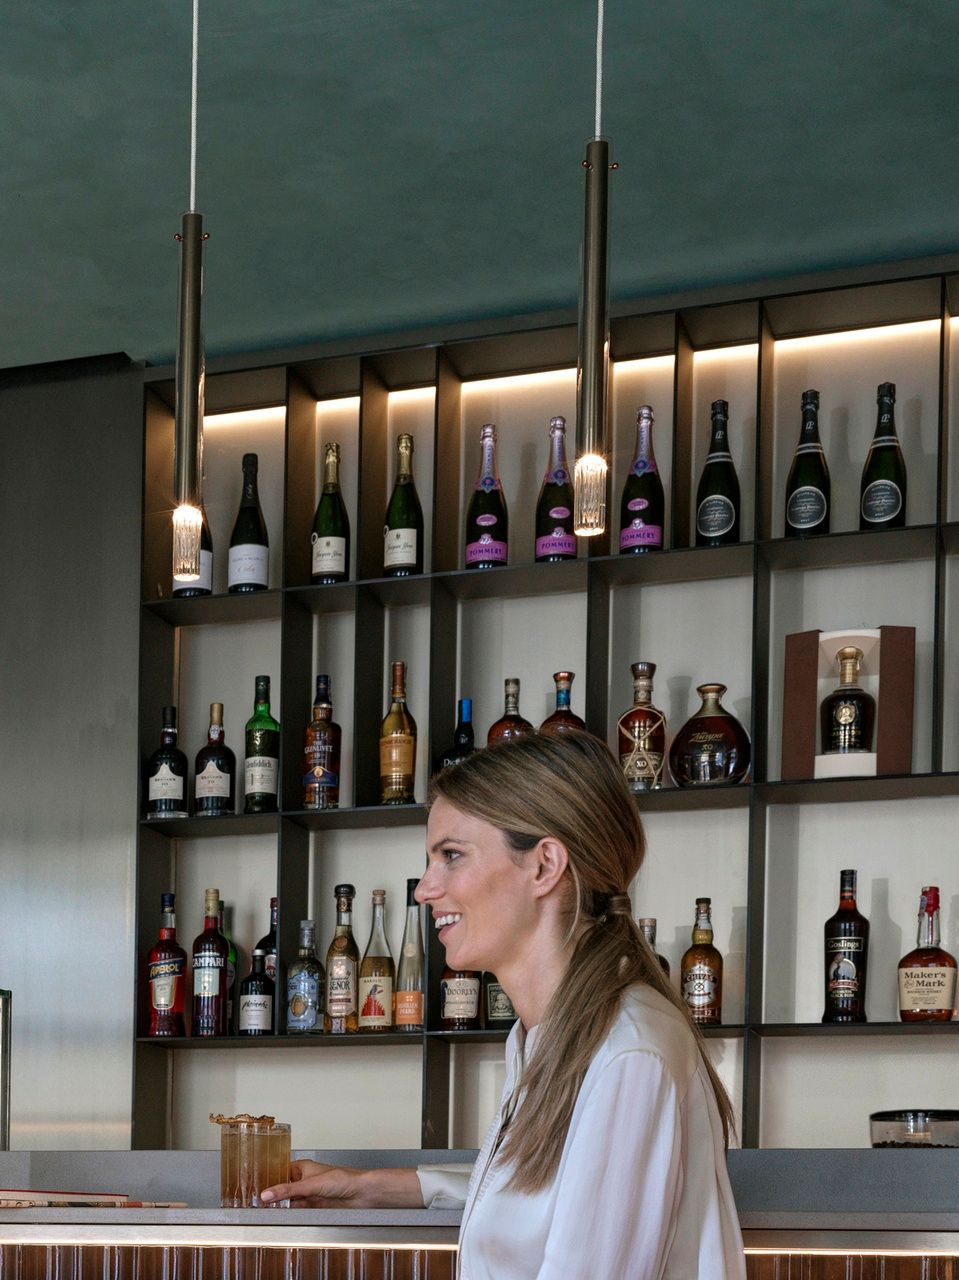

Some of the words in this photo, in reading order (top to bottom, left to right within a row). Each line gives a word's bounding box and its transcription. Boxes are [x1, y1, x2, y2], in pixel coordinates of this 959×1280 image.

[304, 745, 334, 754] GLENLIVET
[828, 940, 859, 949] Goslings
[149, 963, 179, 977] APEROL
[686, 973, 714, 982] CHIVAS
[904, 971, 946, 979] Maker's
